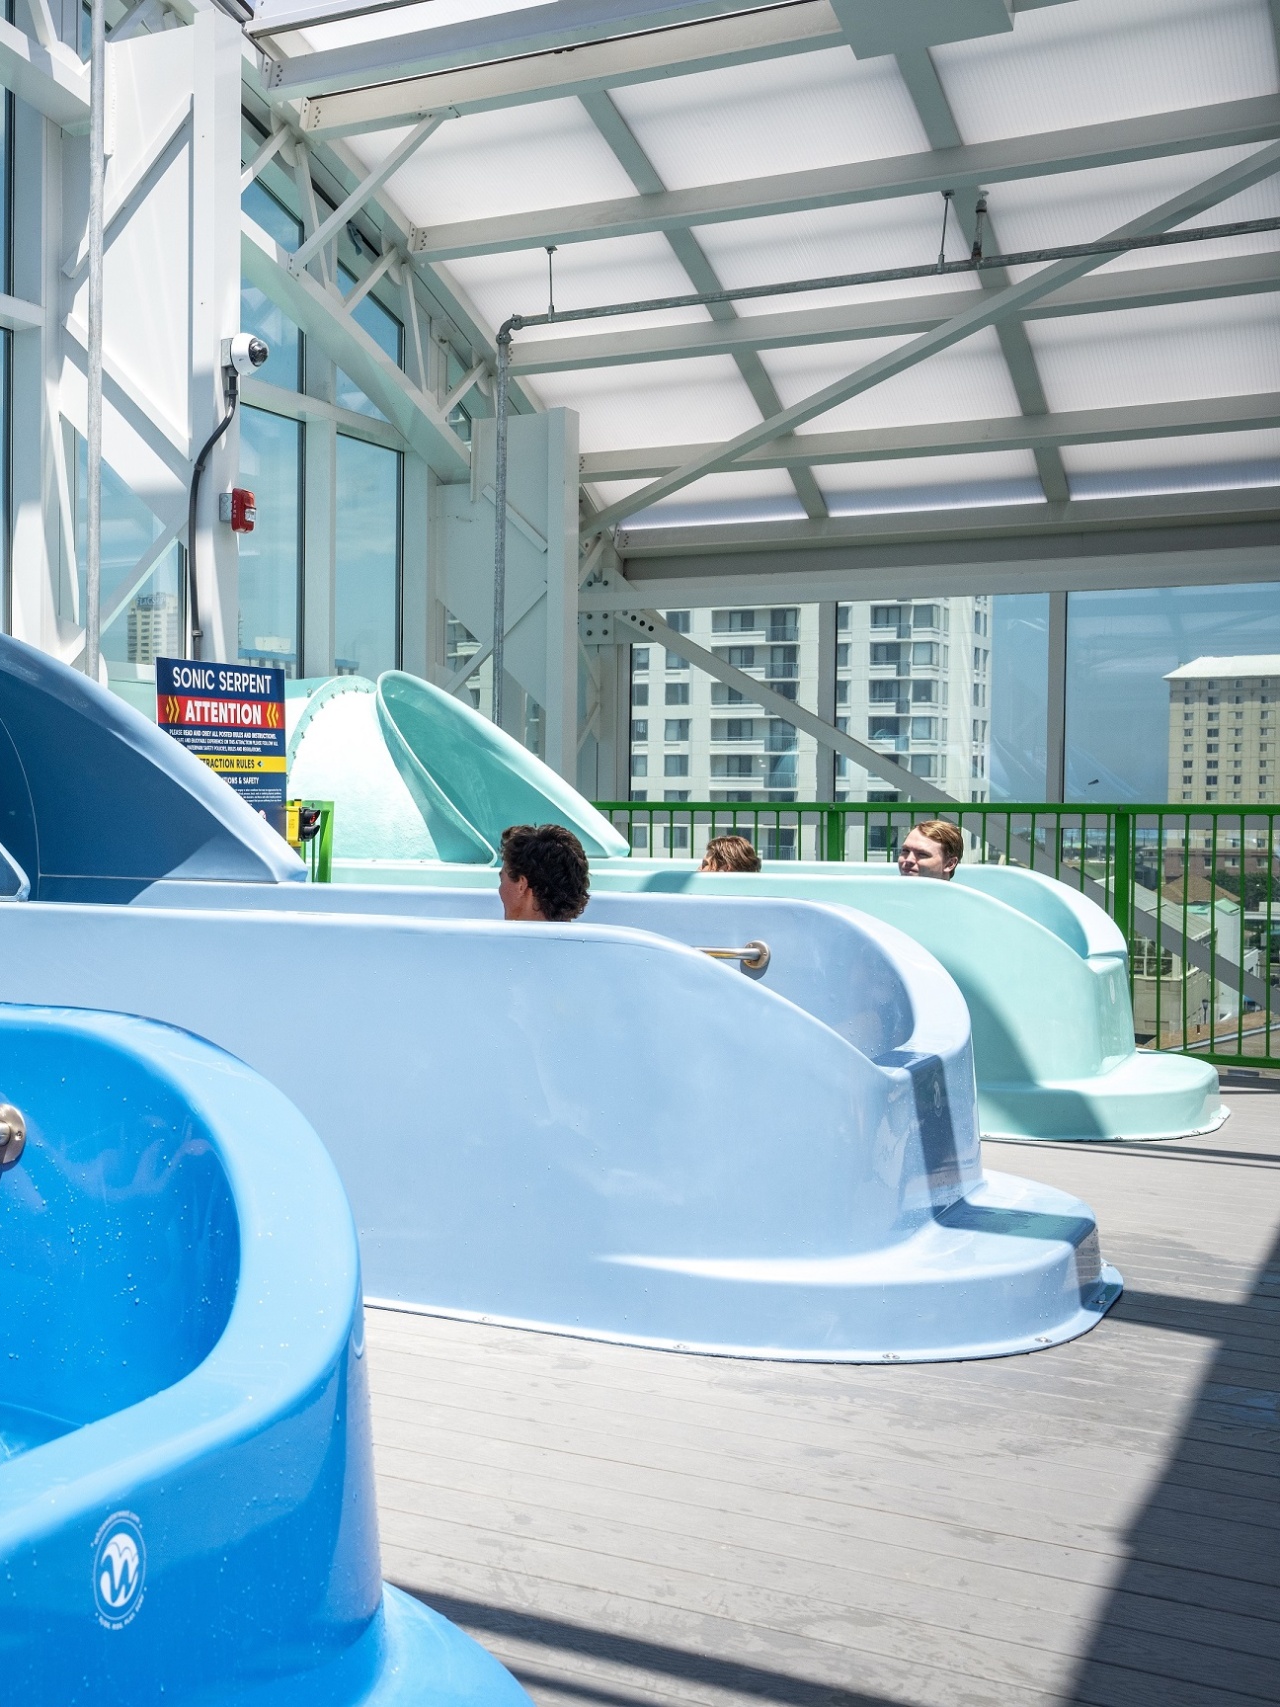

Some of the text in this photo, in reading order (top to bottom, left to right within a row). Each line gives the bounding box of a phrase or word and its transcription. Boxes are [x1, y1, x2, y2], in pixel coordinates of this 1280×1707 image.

[172, 667, 271, 694] SONIC SERPENT
[185, 700, 261, 724] ATTENTION
[236, 760, 254, 768] RULES
